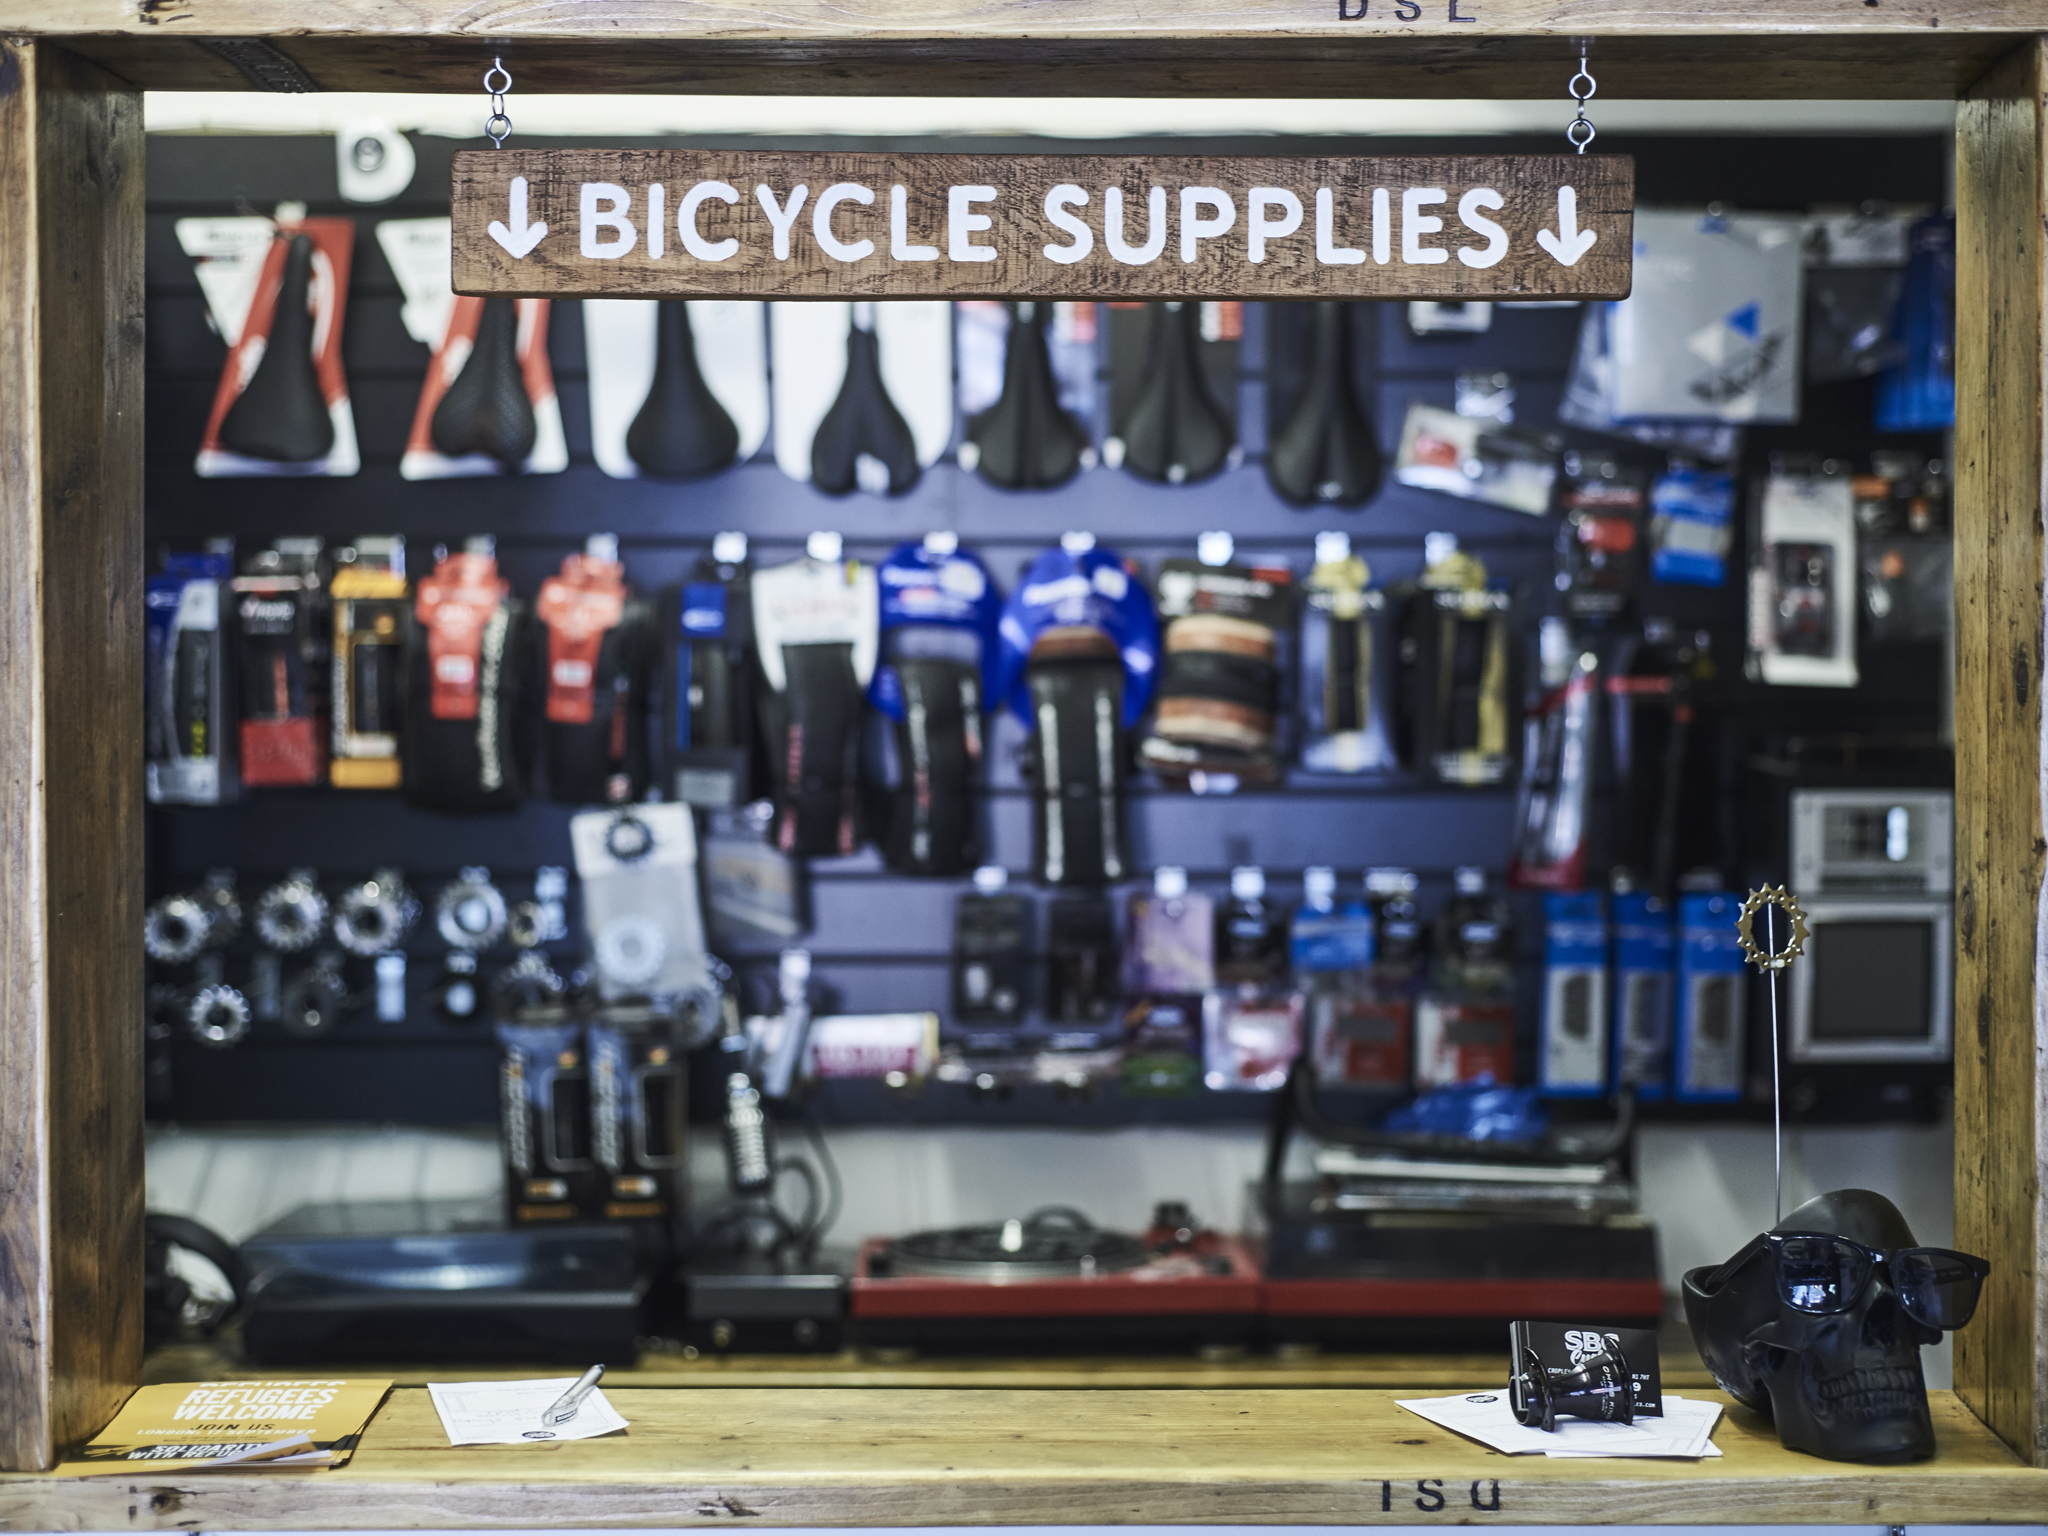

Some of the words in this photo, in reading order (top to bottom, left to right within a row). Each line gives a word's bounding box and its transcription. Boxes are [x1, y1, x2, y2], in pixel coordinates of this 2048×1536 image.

[579, 180, 998, 263] BICYCLE
[1042, 183, 1509, 269] SUPPLIES
[183, 1388, 339, 1405] REFUGEES
[172, 1404, 324, 1420] WELCOME
[226, 1428, 317, 1436] SEPTEMBER
[248, 1423, 275, 1431] US
[127, 1450, 177, 1460] WITH
[181, 1449, 243, 1458] REFU
